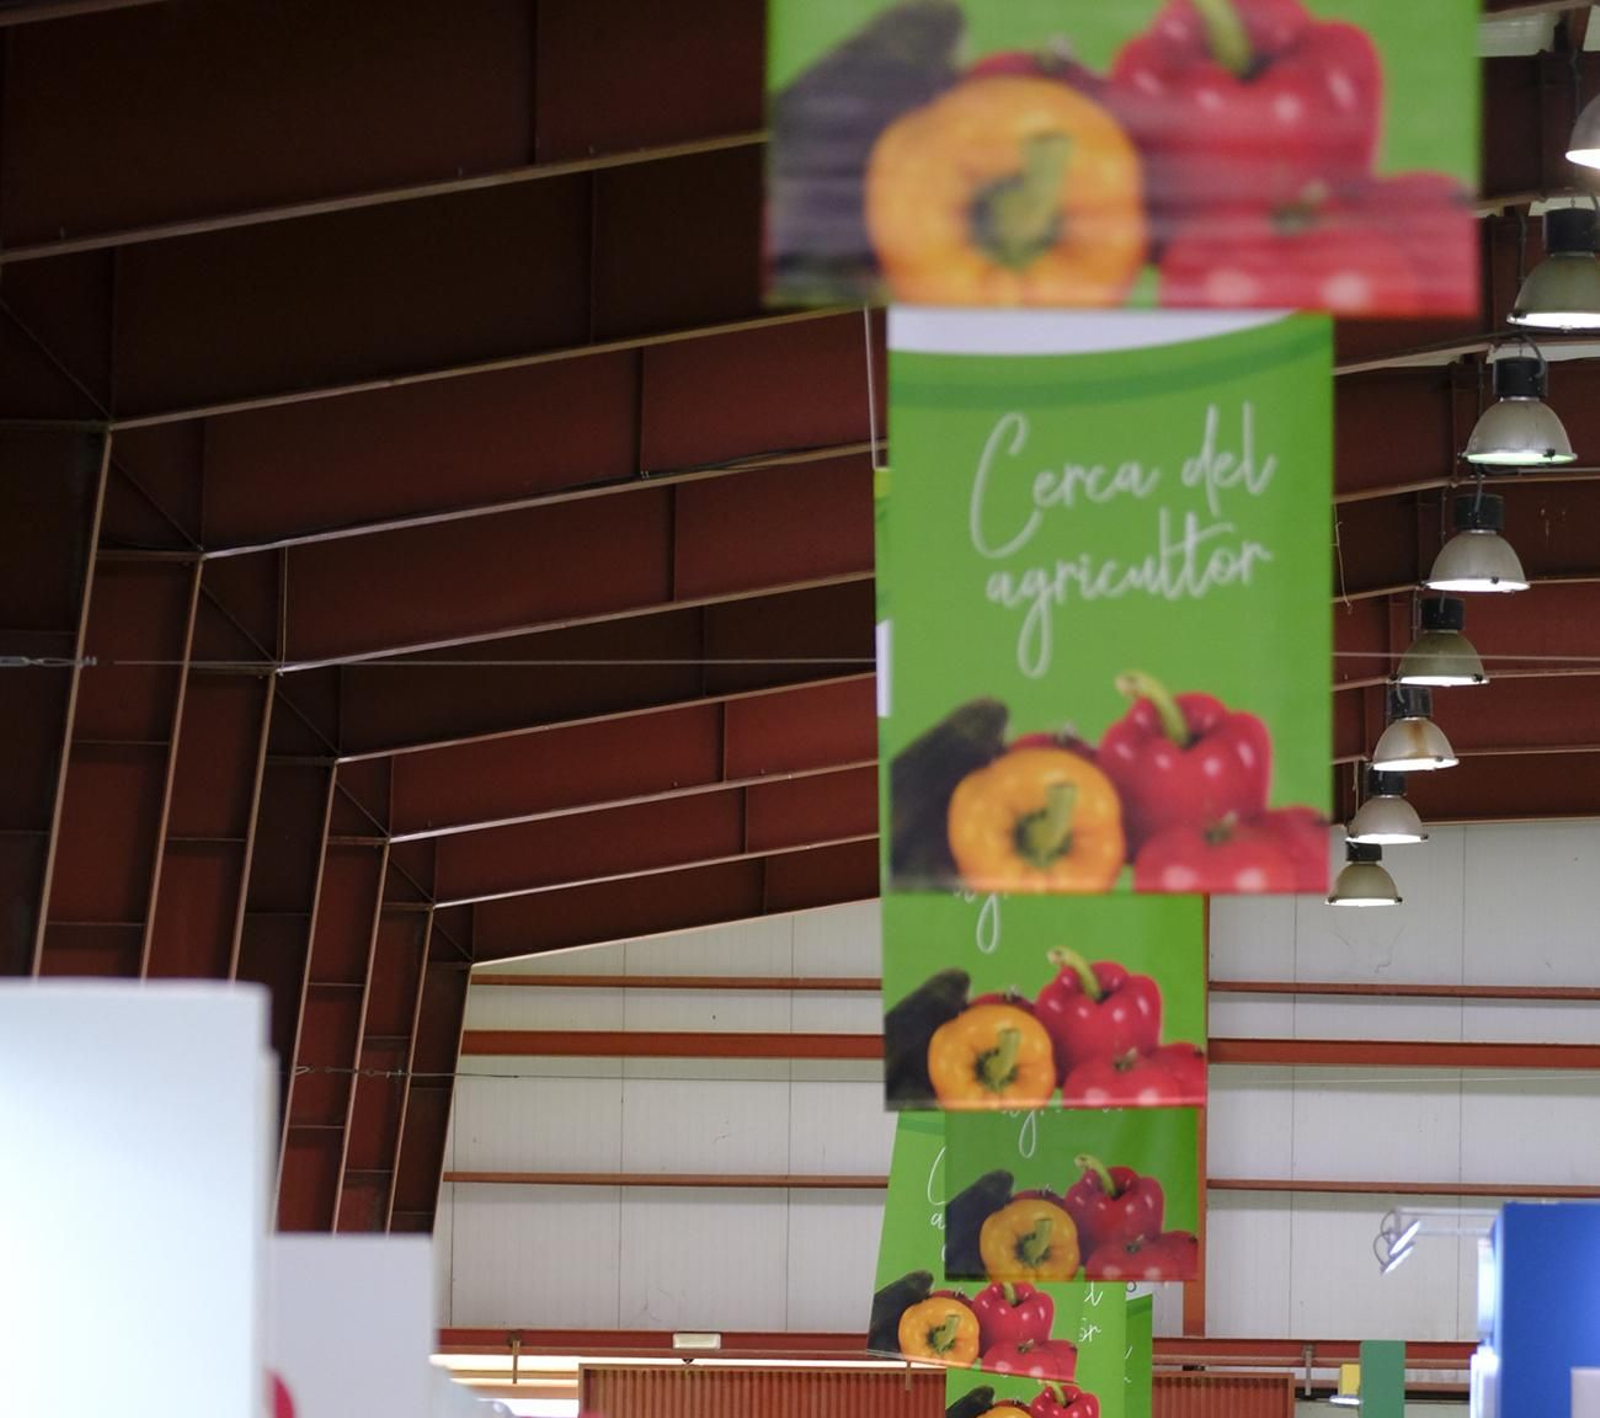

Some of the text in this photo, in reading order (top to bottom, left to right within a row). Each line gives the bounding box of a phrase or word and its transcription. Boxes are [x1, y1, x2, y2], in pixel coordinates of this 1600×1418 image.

[970, 400, 1276, 559] Cerca del
[985, 505, 1273, 678] agricultor
